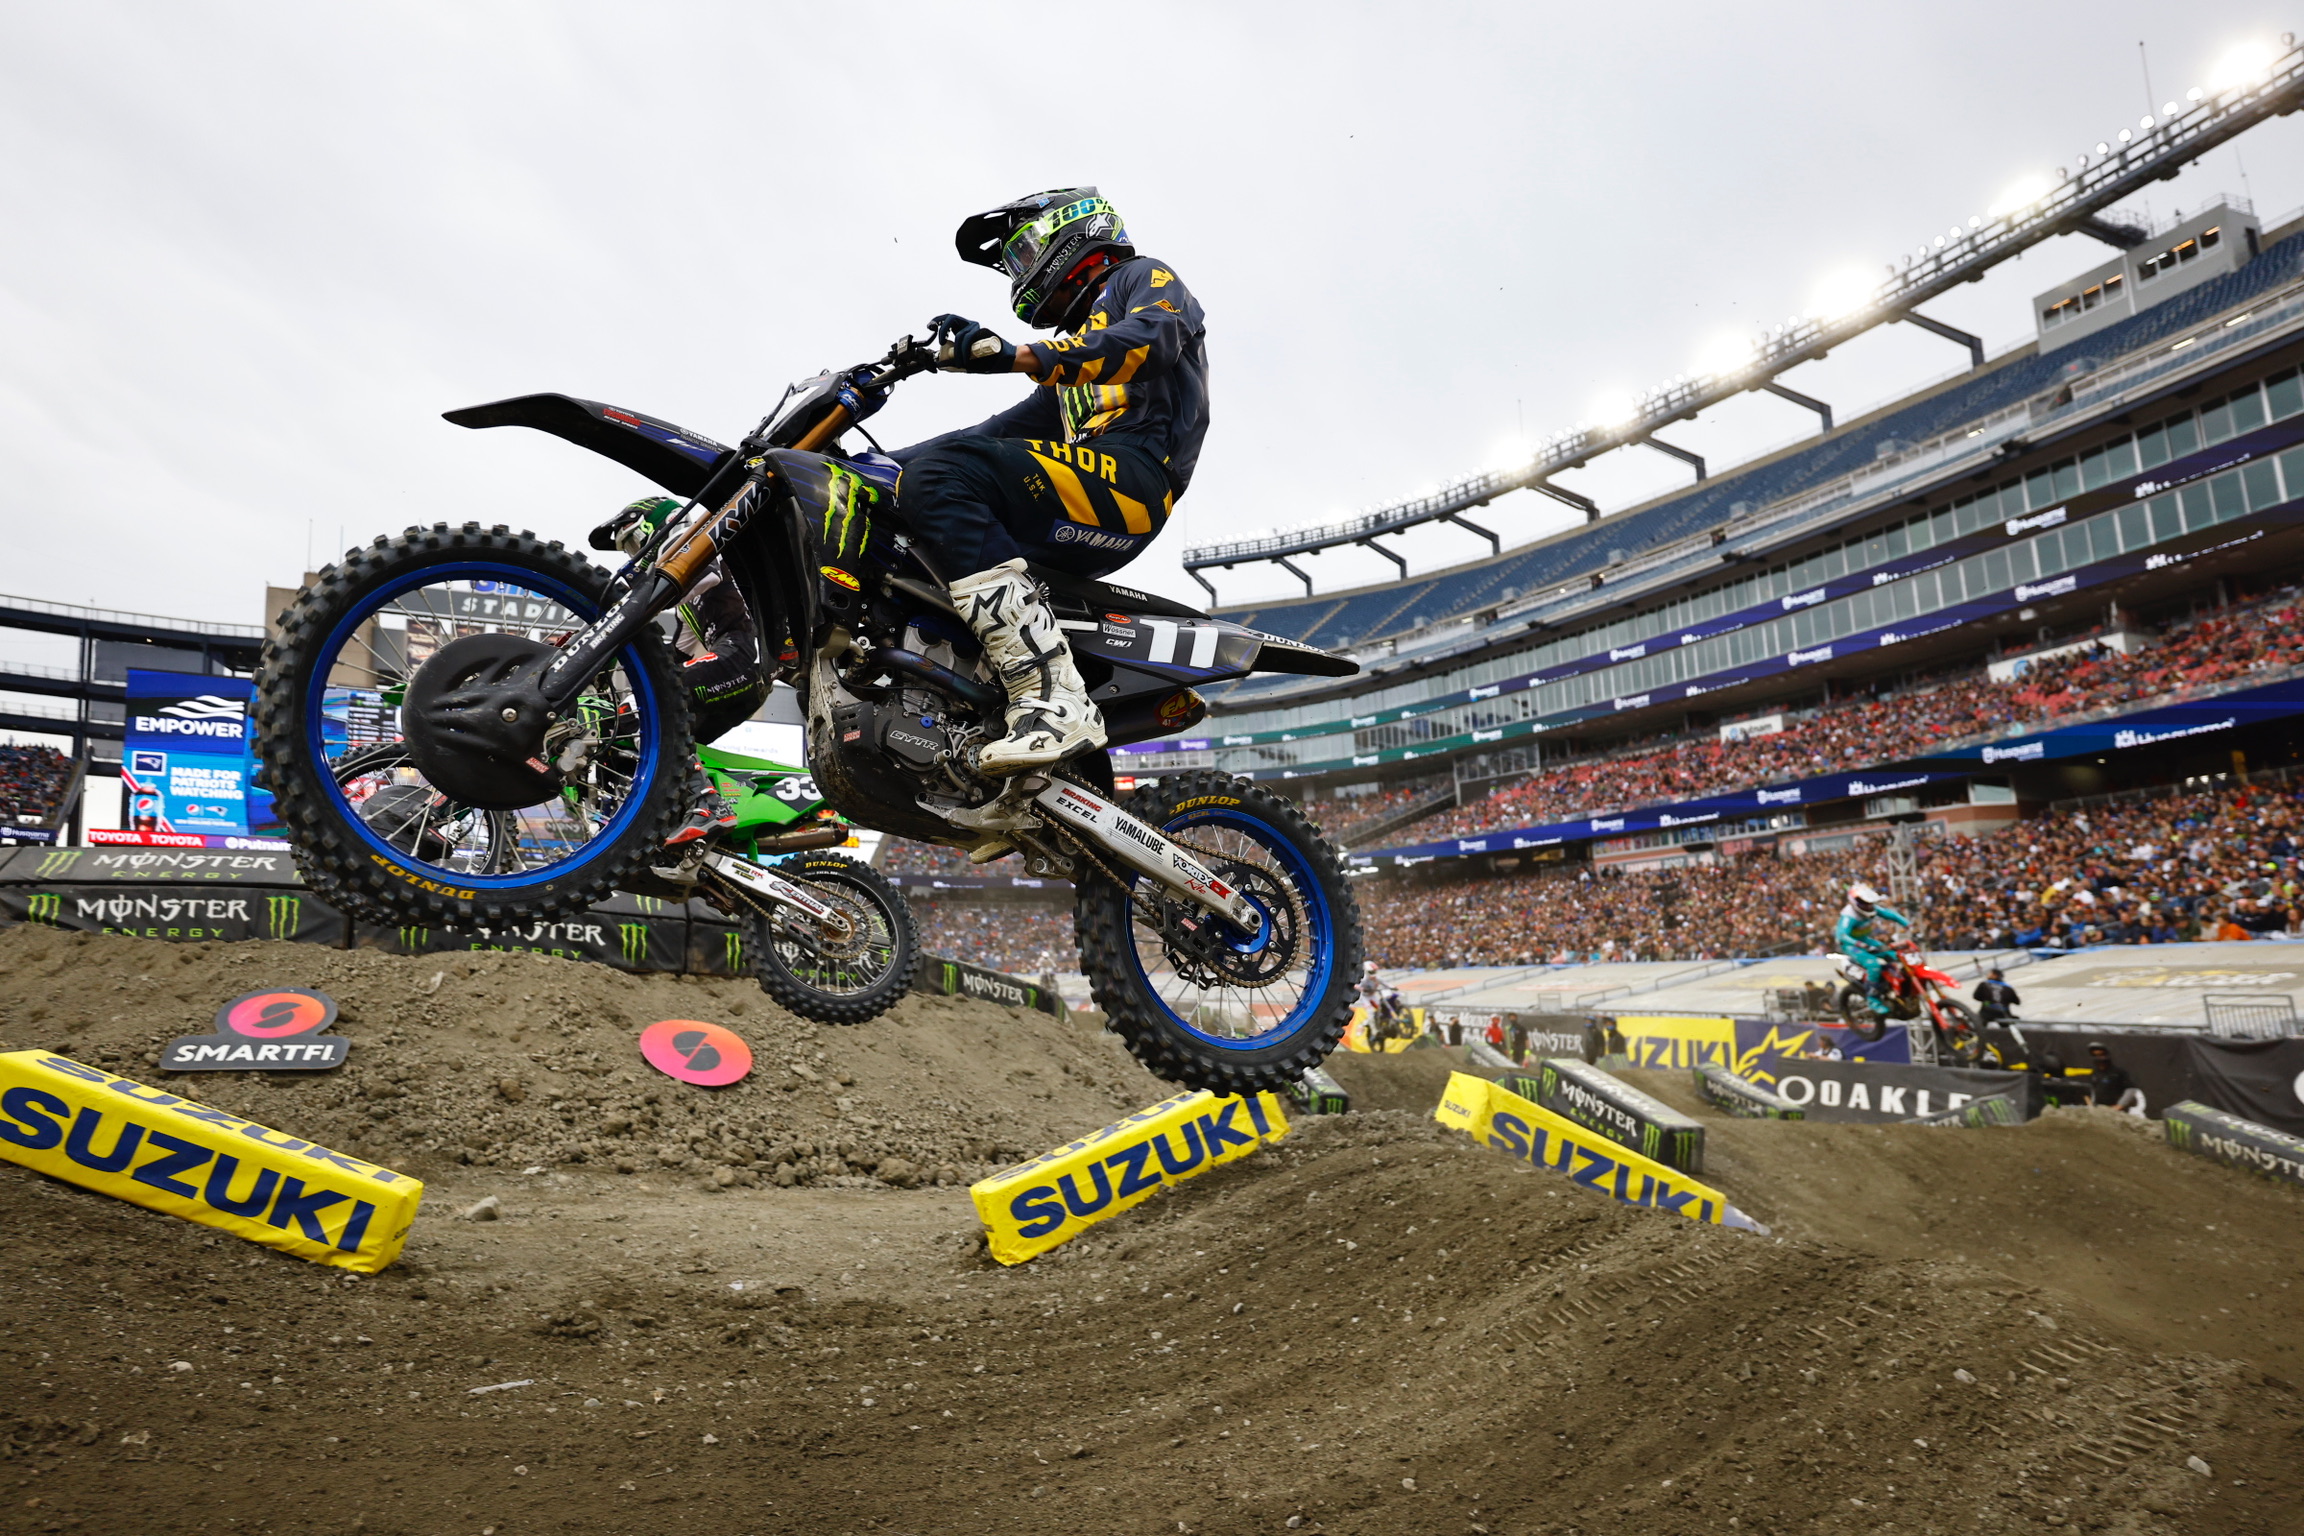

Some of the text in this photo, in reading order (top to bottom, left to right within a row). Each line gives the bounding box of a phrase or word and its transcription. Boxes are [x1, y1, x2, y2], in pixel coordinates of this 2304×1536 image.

[1046, 233, 1083, 274] MONSTER
[1023, 439, 1117, 484] THOR
[1074, 529, 1135, 551] YAMAHA
[1109, 584, 1148, 602] YAMAHA
[589, 612, 625, 650] BRAKING
[1139, 618, 1219, 669] 11
[135, 716, 244, 739] EMPOWER
[890, 730, 939, 750] GYTR
[170, 767, 242, 781] MADE FOR
[170, 777, 237, 790] PATRIOTS
[170, 787, 245, 800] WATCHING
[1061, 787, 1102, 812] BRAKING
[1174, 795, 1241, 814] DUNLOP
[1056, 796, 1098, 824] EXCEL
[89, 831, 203, 846] TOYOTA TOYOTA
[1114, 816, 1166, 856] YAMALUBE
[92, 852, 277, 871] MONSTER
[111, 871, 243, 880] ENERGY
[804, 860, 848, 869] DUNLOP
[1173, 853, 1213, 888] VORTEX
[370, 854, 477, 900] DUNLOP
[77, 893, 251, 922] MONSTER
[101, 927, 225, 938] ENERGY
[962, 964, 1024, 1005] MONSTER
[1624, 1035, 1733, 1070] UZUKI
[36, 1056, 401, 1183] SUZUKI
[1443, 1097, 1472, 1119] SUZUKI
[1560, 1080, 1638, 1138] MONSTER
[0, 1086, 376, 1253] SUZUKI
[1009, 1095, 1272, 1239] SUZUKI
[1488, 1111, 1714, 1223] SUZUKI
